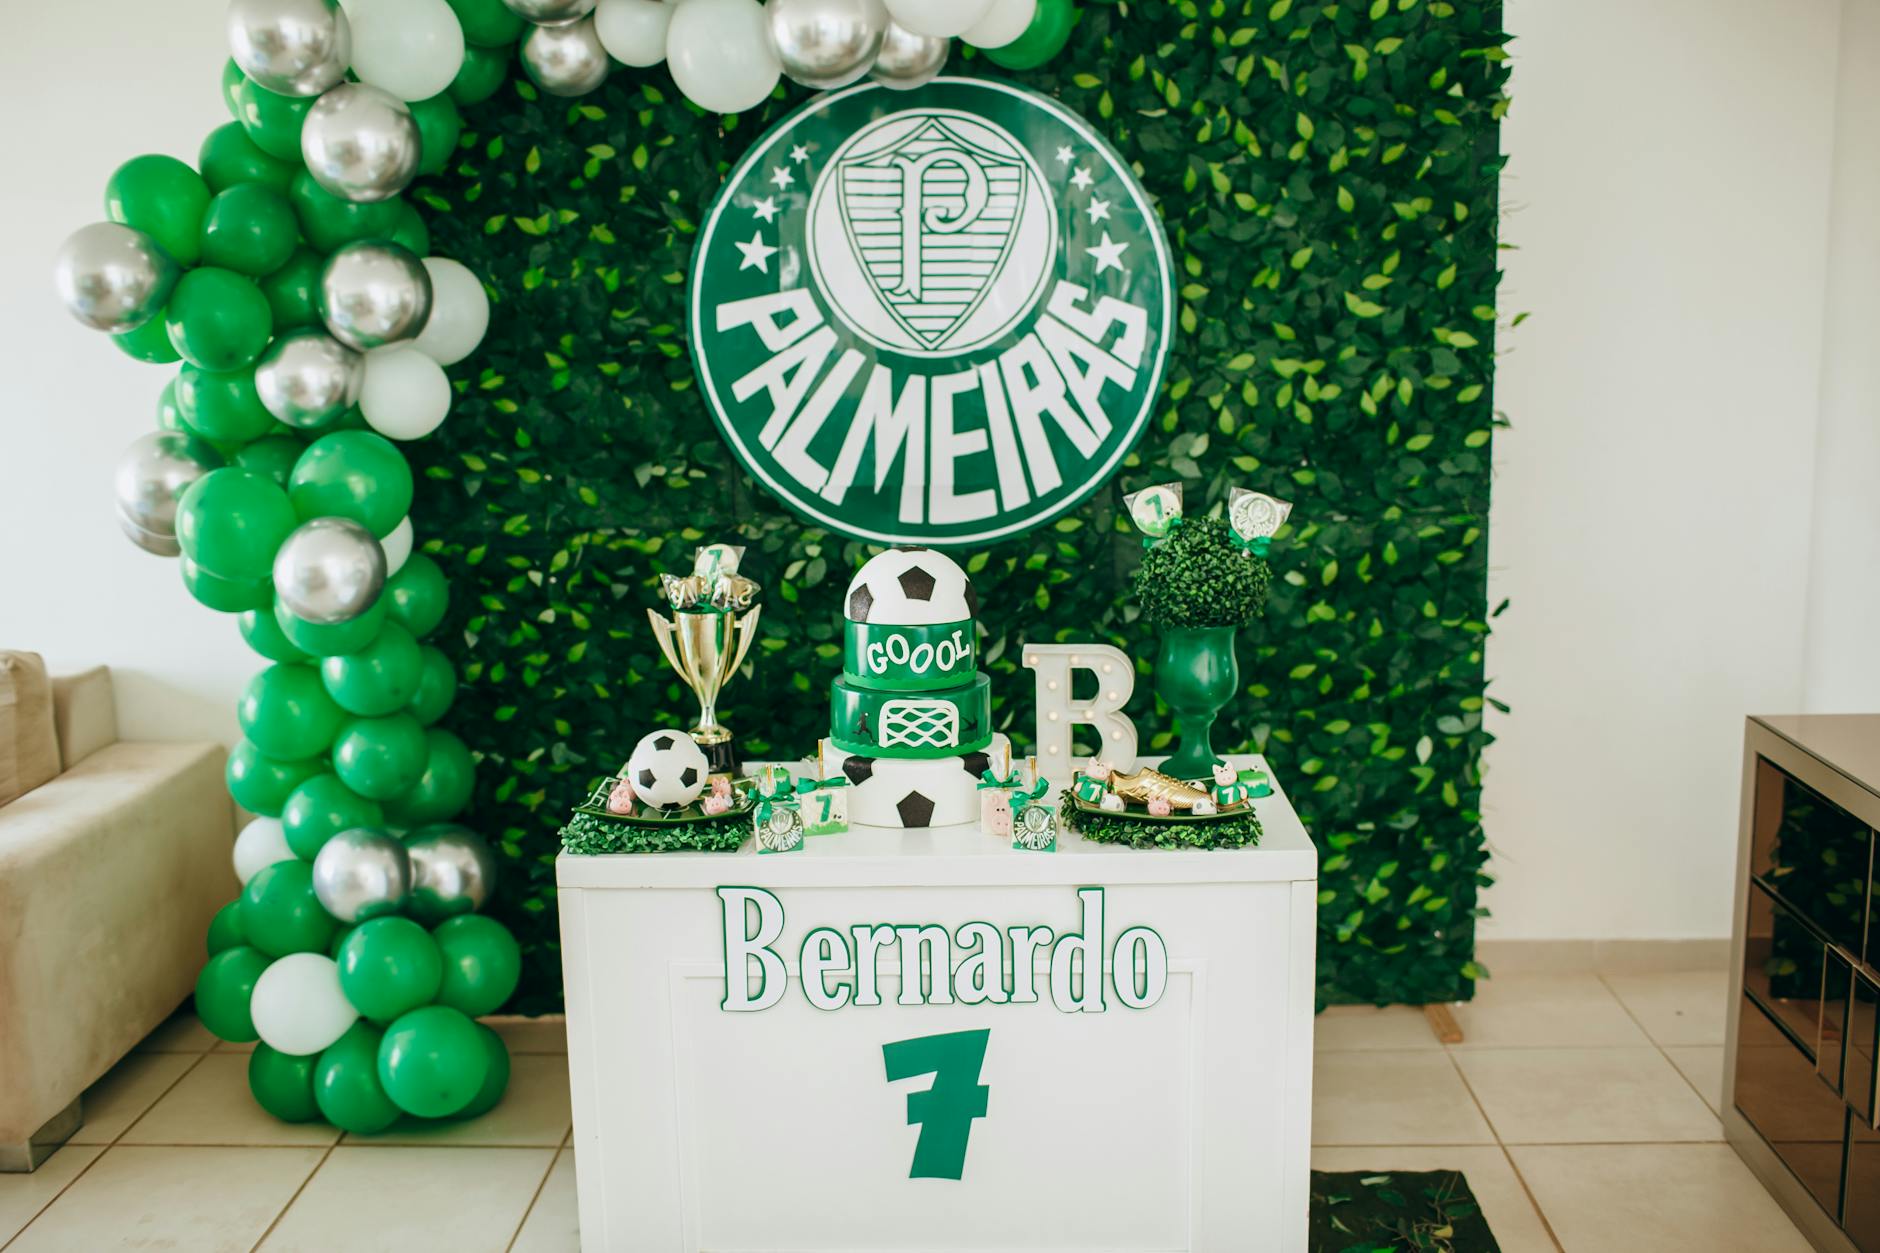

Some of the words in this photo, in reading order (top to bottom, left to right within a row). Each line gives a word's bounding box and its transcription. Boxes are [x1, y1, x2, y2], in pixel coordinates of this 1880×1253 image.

[884, 148, 989, 302] P
[716, 279, 1147, 524] PALMEIRAS
[1145, 494, 1163, 520] 7
[867, 630, 970, 674] GOOOL
[1022, 643, 1138, 782] B
[816, 794, 832, 822] 7
[1089, 783, 1102, 801] 7
[1222, 786, 1234, 805] 7
[1014, 821, 1055, 850] PALMEIRAS
[717, 886, 1168, 1013] Bernardo
[882, 1028, 991, 1181] 7
